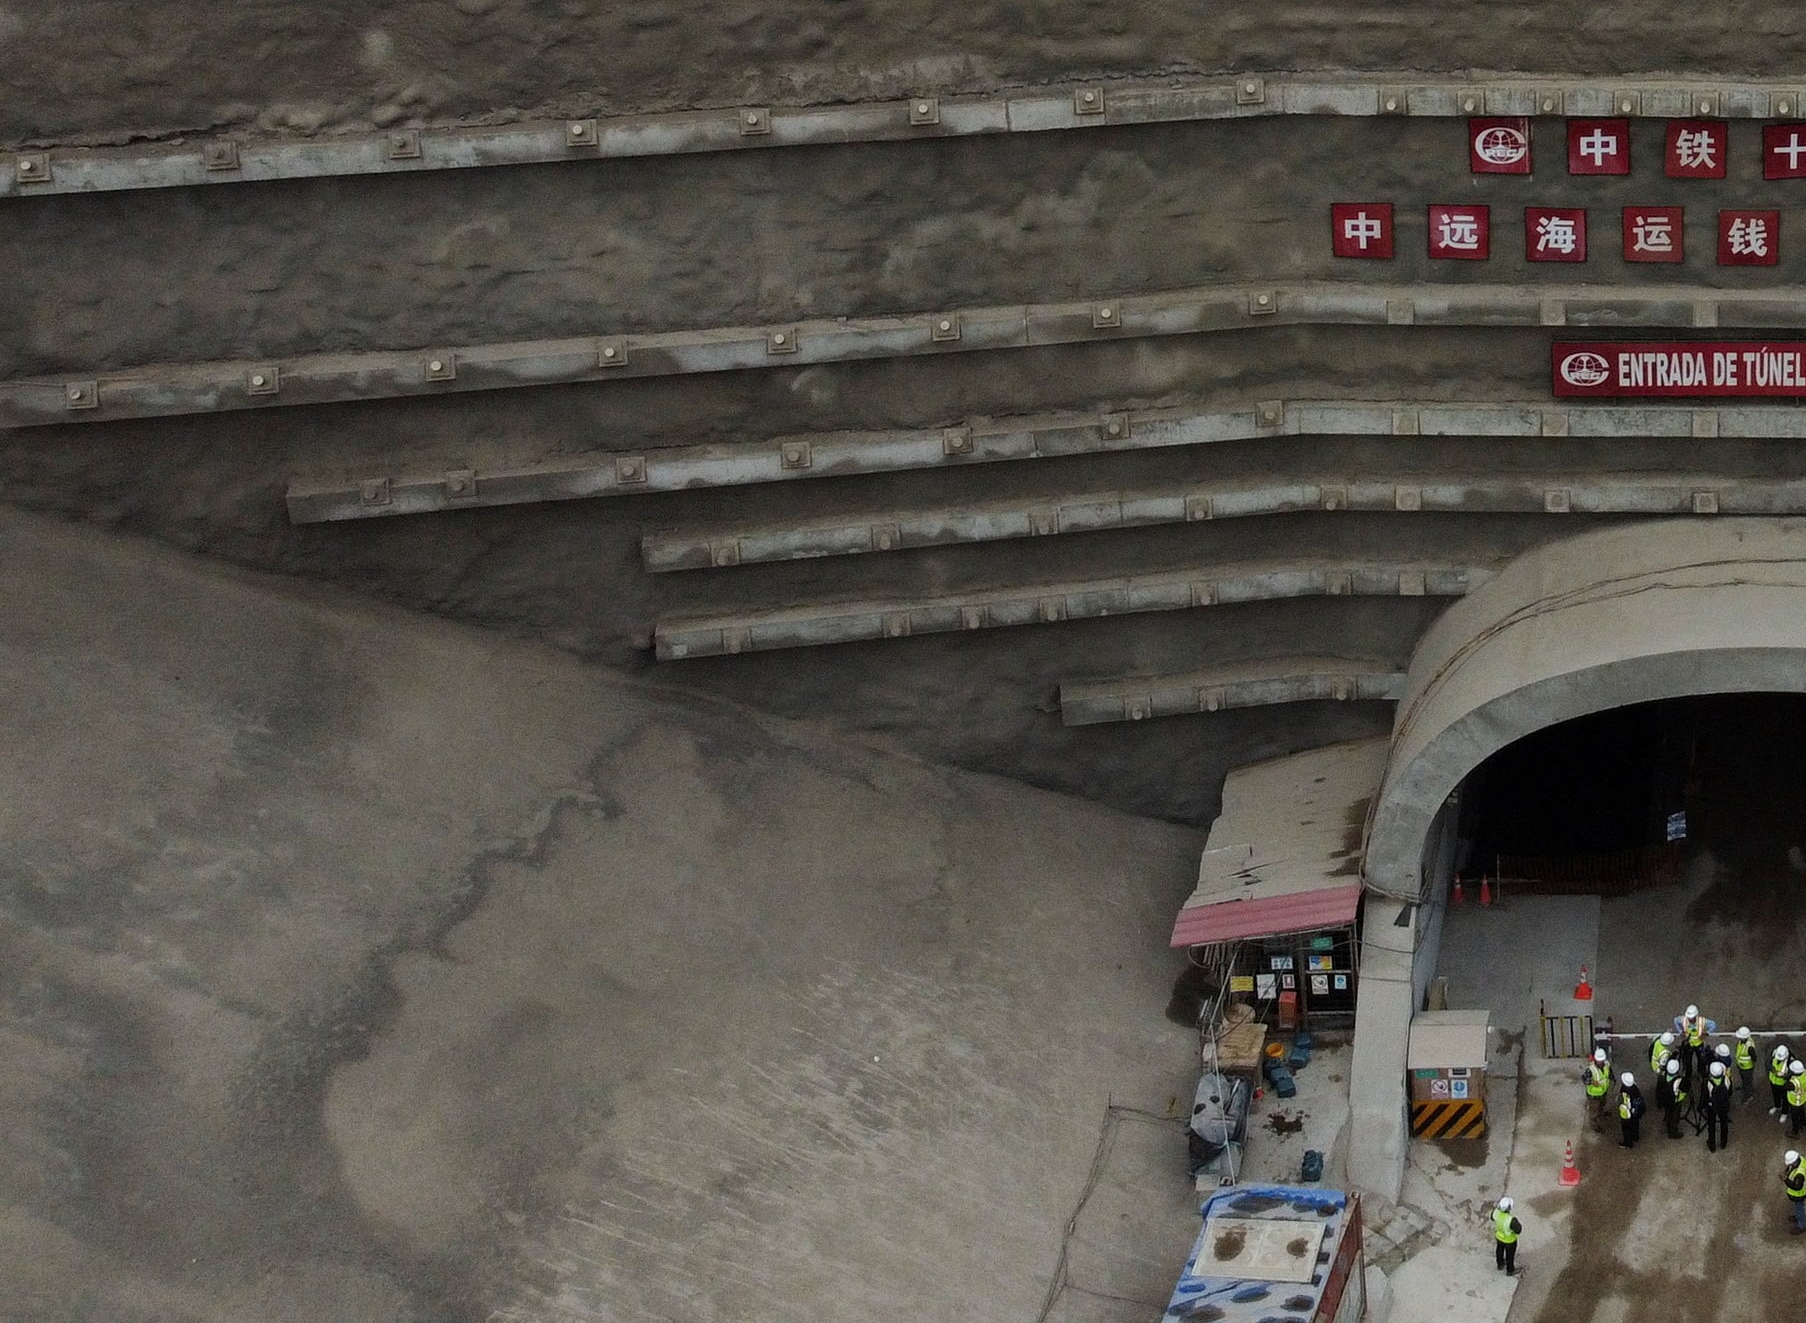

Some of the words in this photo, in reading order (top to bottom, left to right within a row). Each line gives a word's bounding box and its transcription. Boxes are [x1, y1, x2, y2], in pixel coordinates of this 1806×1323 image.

[1618, 352, 1707, 387] ENTRADA
[1713, 352, 1738, 387] DE
[1743, 346, 1806, 387] TÚNEL
